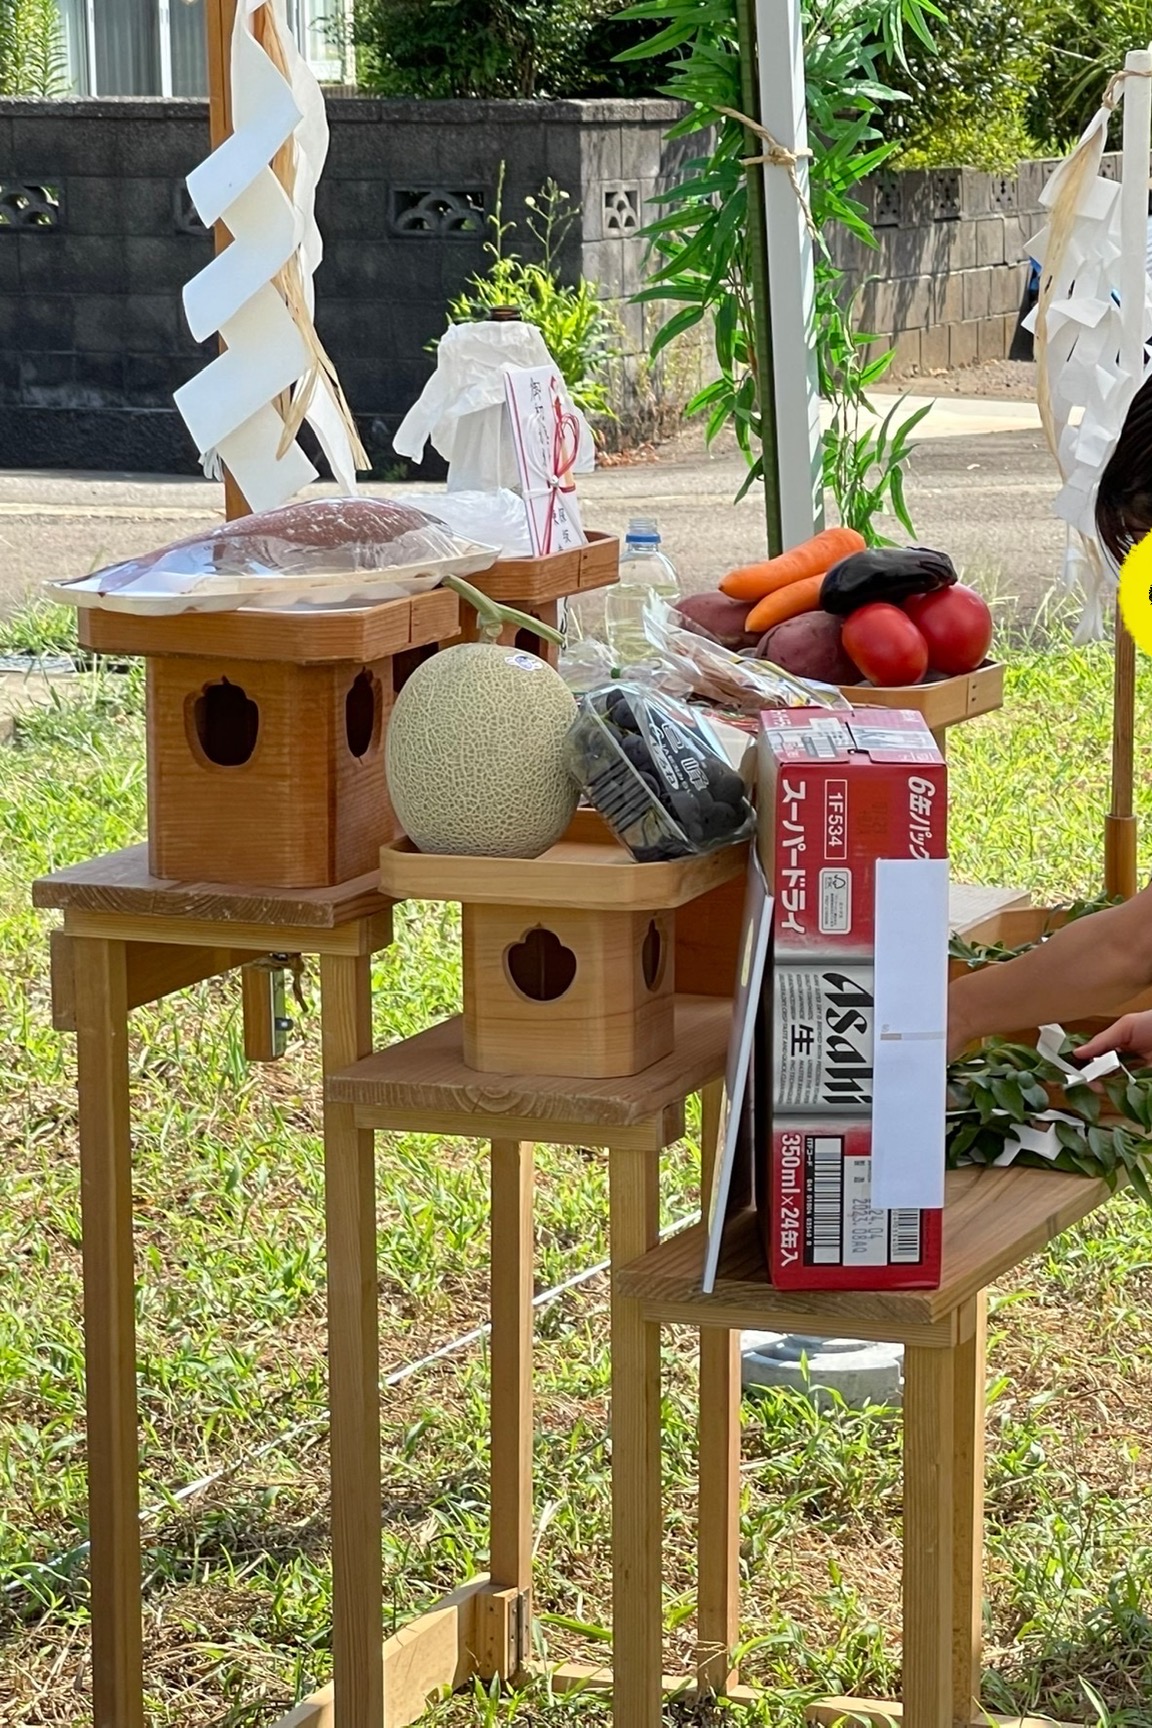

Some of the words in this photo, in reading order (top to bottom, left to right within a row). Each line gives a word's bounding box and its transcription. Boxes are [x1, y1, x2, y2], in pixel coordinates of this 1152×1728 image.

[781, 779, 806, 934] スーパードライ
[828, 792, 844, 848] 1F534
[908, 776, 936, 860] 6缶パック
[791, 1023, 814, 1056] 生
[822, 972, 874, 1104] Asahi
